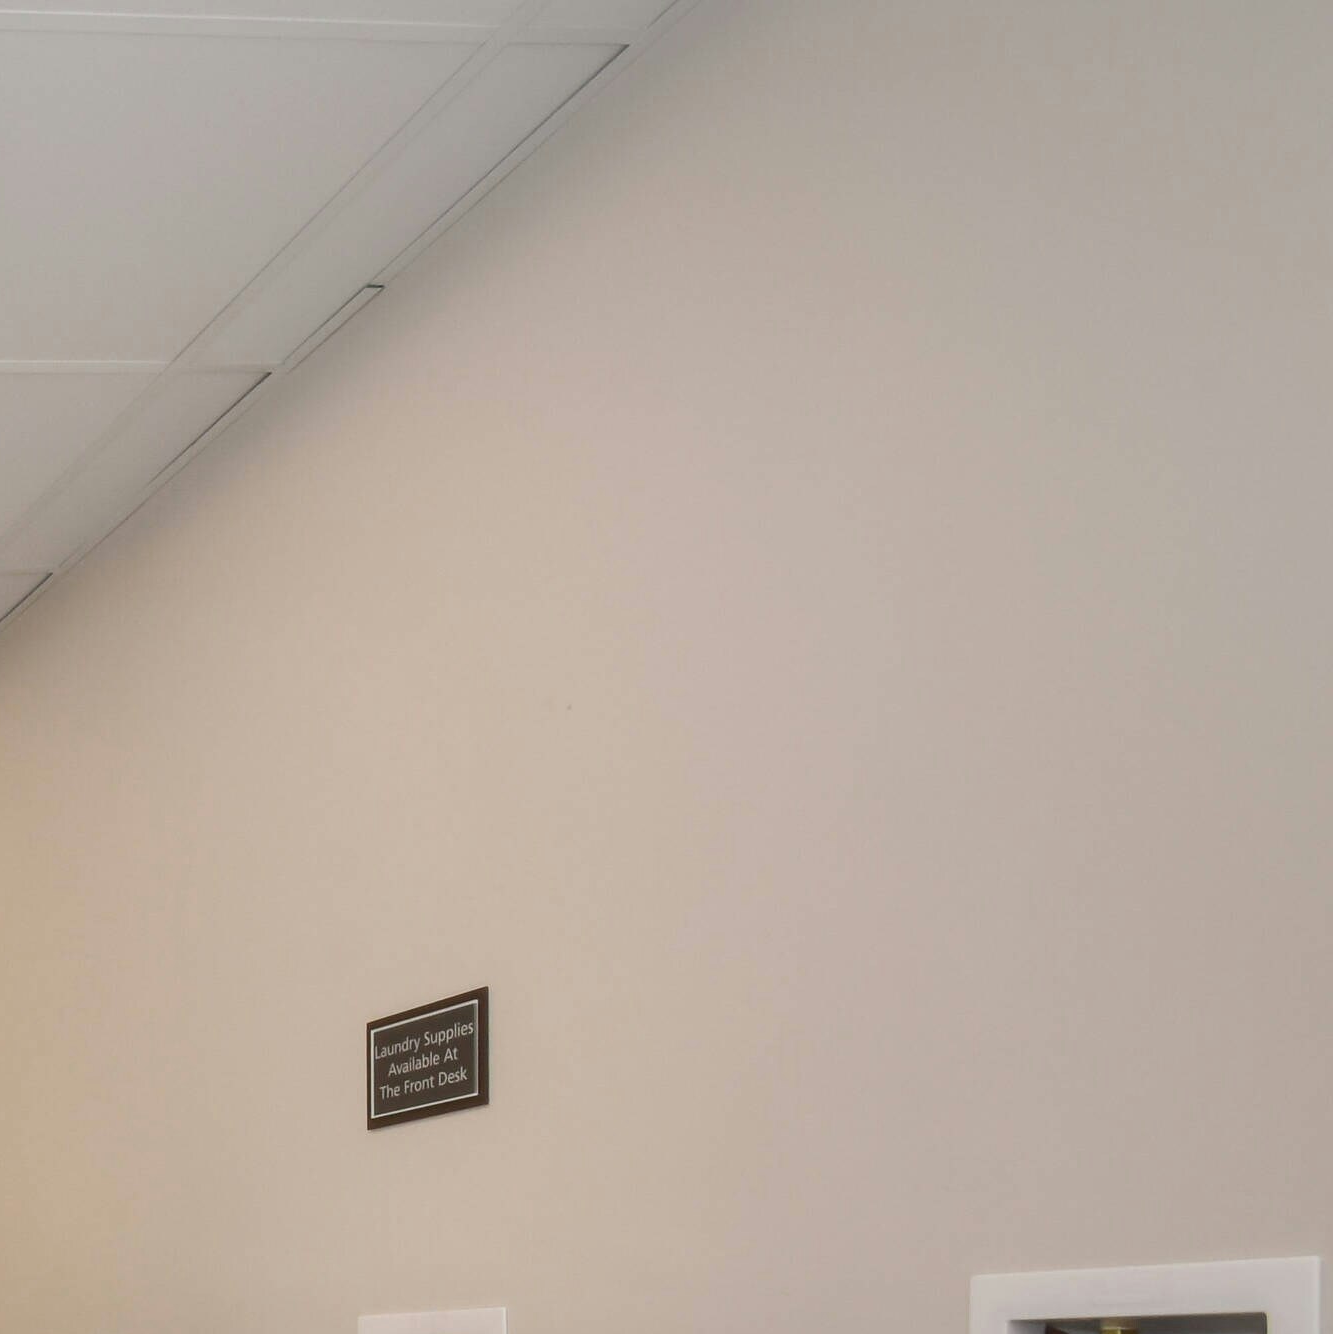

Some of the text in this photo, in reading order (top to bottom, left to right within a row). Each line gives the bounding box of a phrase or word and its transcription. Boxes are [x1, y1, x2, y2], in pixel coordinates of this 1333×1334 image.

[374, 1022, 474, 1060] Laundry Supplies
[388, 1047, 459, 1077] Available At
[379, 1066, 468, 1100] The Front Desk
